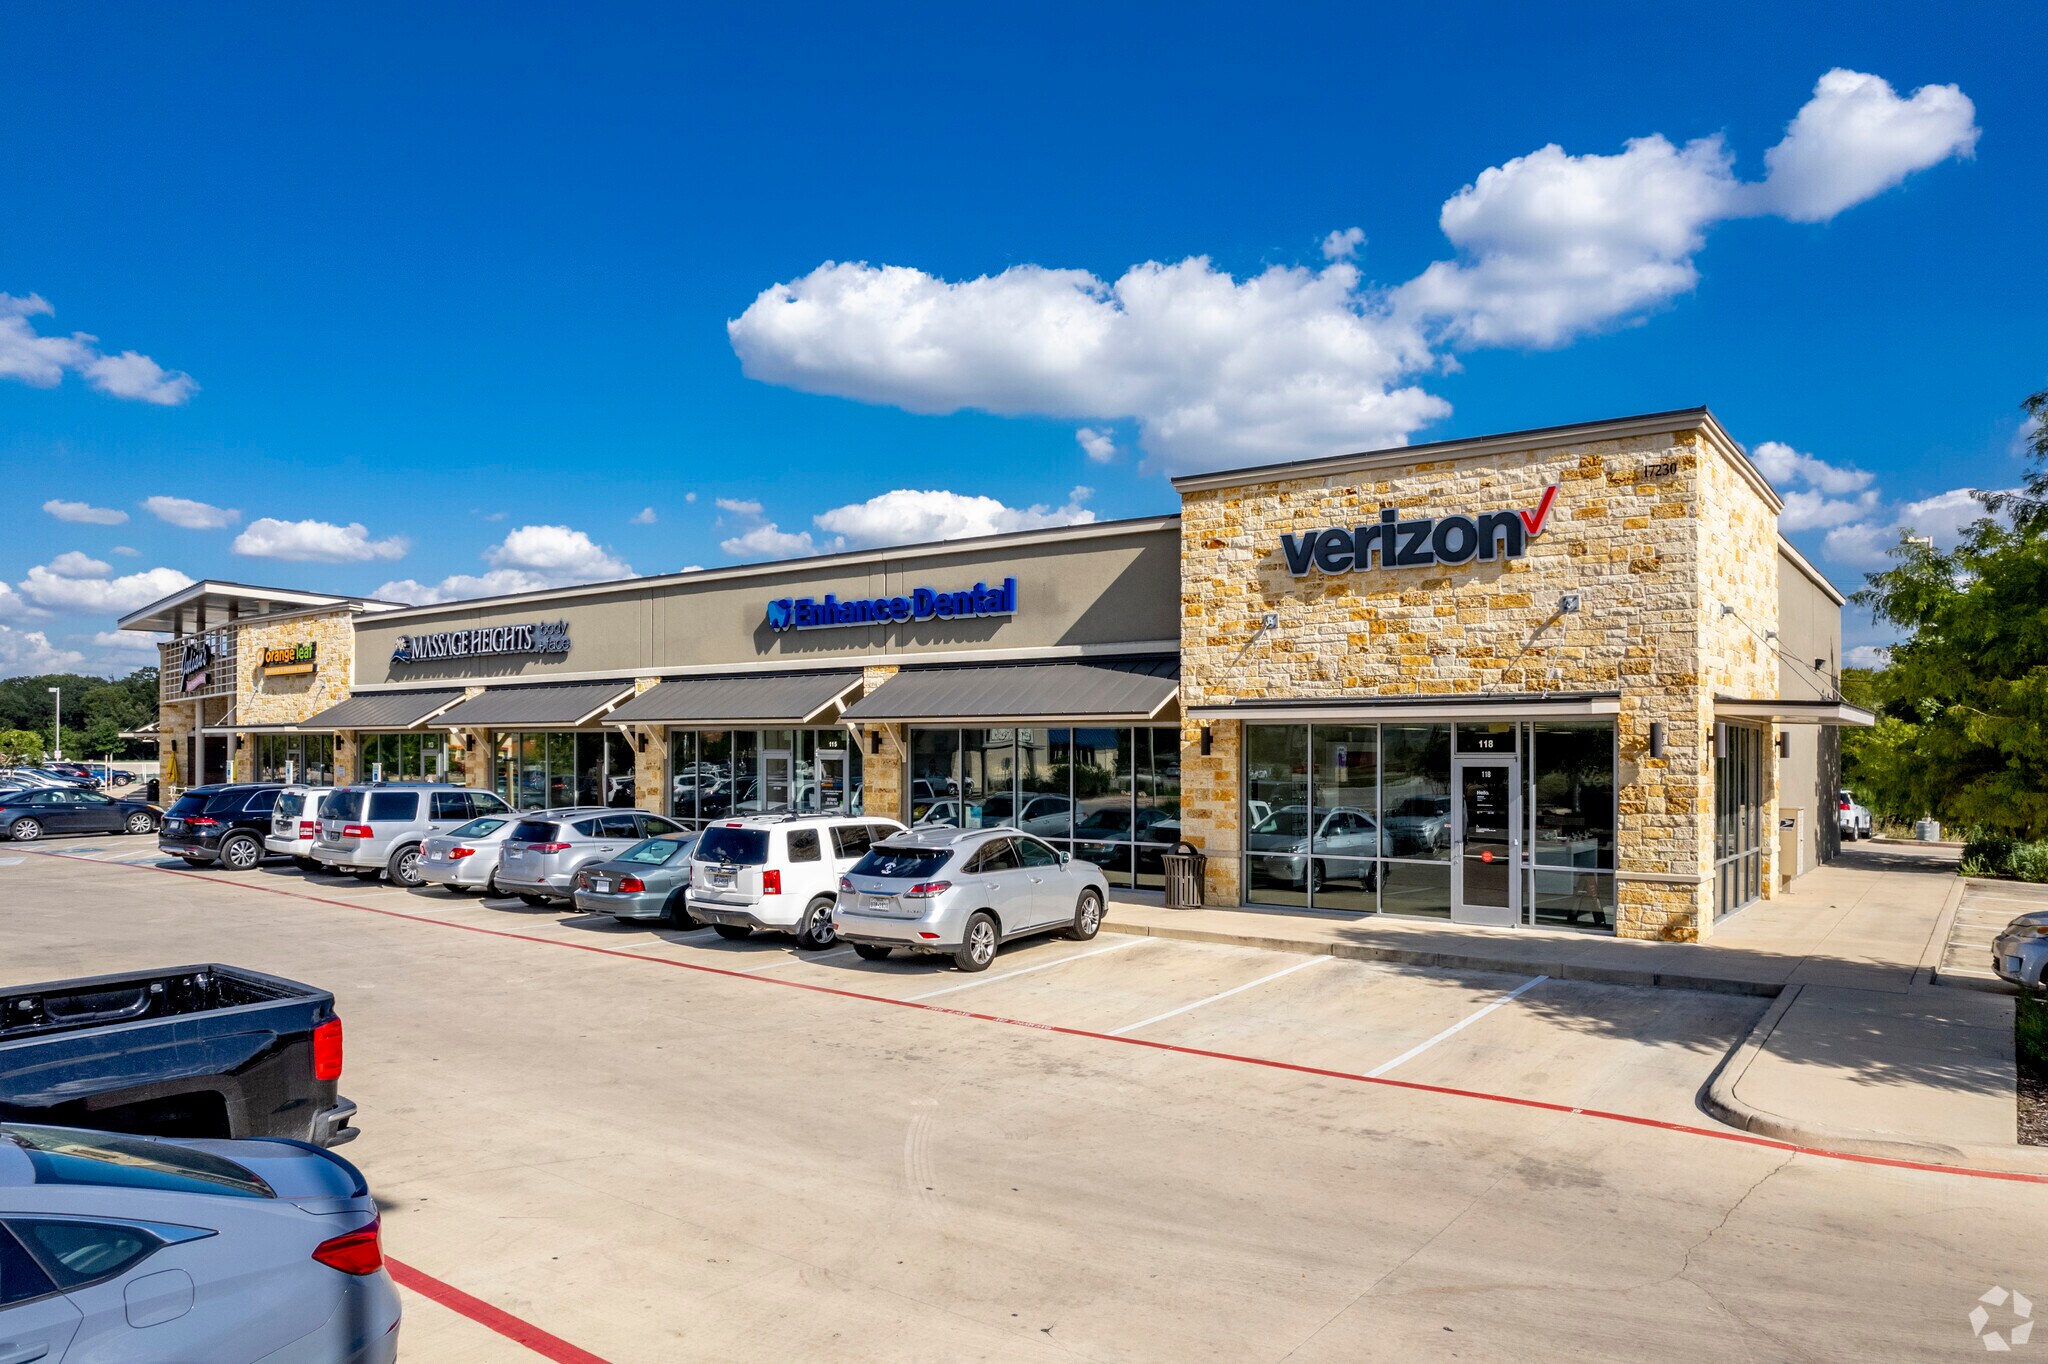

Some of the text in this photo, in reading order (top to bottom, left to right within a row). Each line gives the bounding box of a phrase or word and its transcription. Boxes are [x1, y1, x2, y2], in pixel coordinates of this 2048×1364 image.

[1644, 462, 1677, 478] 17230
[1279, 508, 1523, 575] verizon
[794, 578, 1017, 628] Enhance Dental
[540, 618, 569, 638] body
[265, 642, 313, 663] orange leaf
[411, 625, 532, 659] MASSAGE HEIGHTS
[1478, 739, 1494, 749] 118
